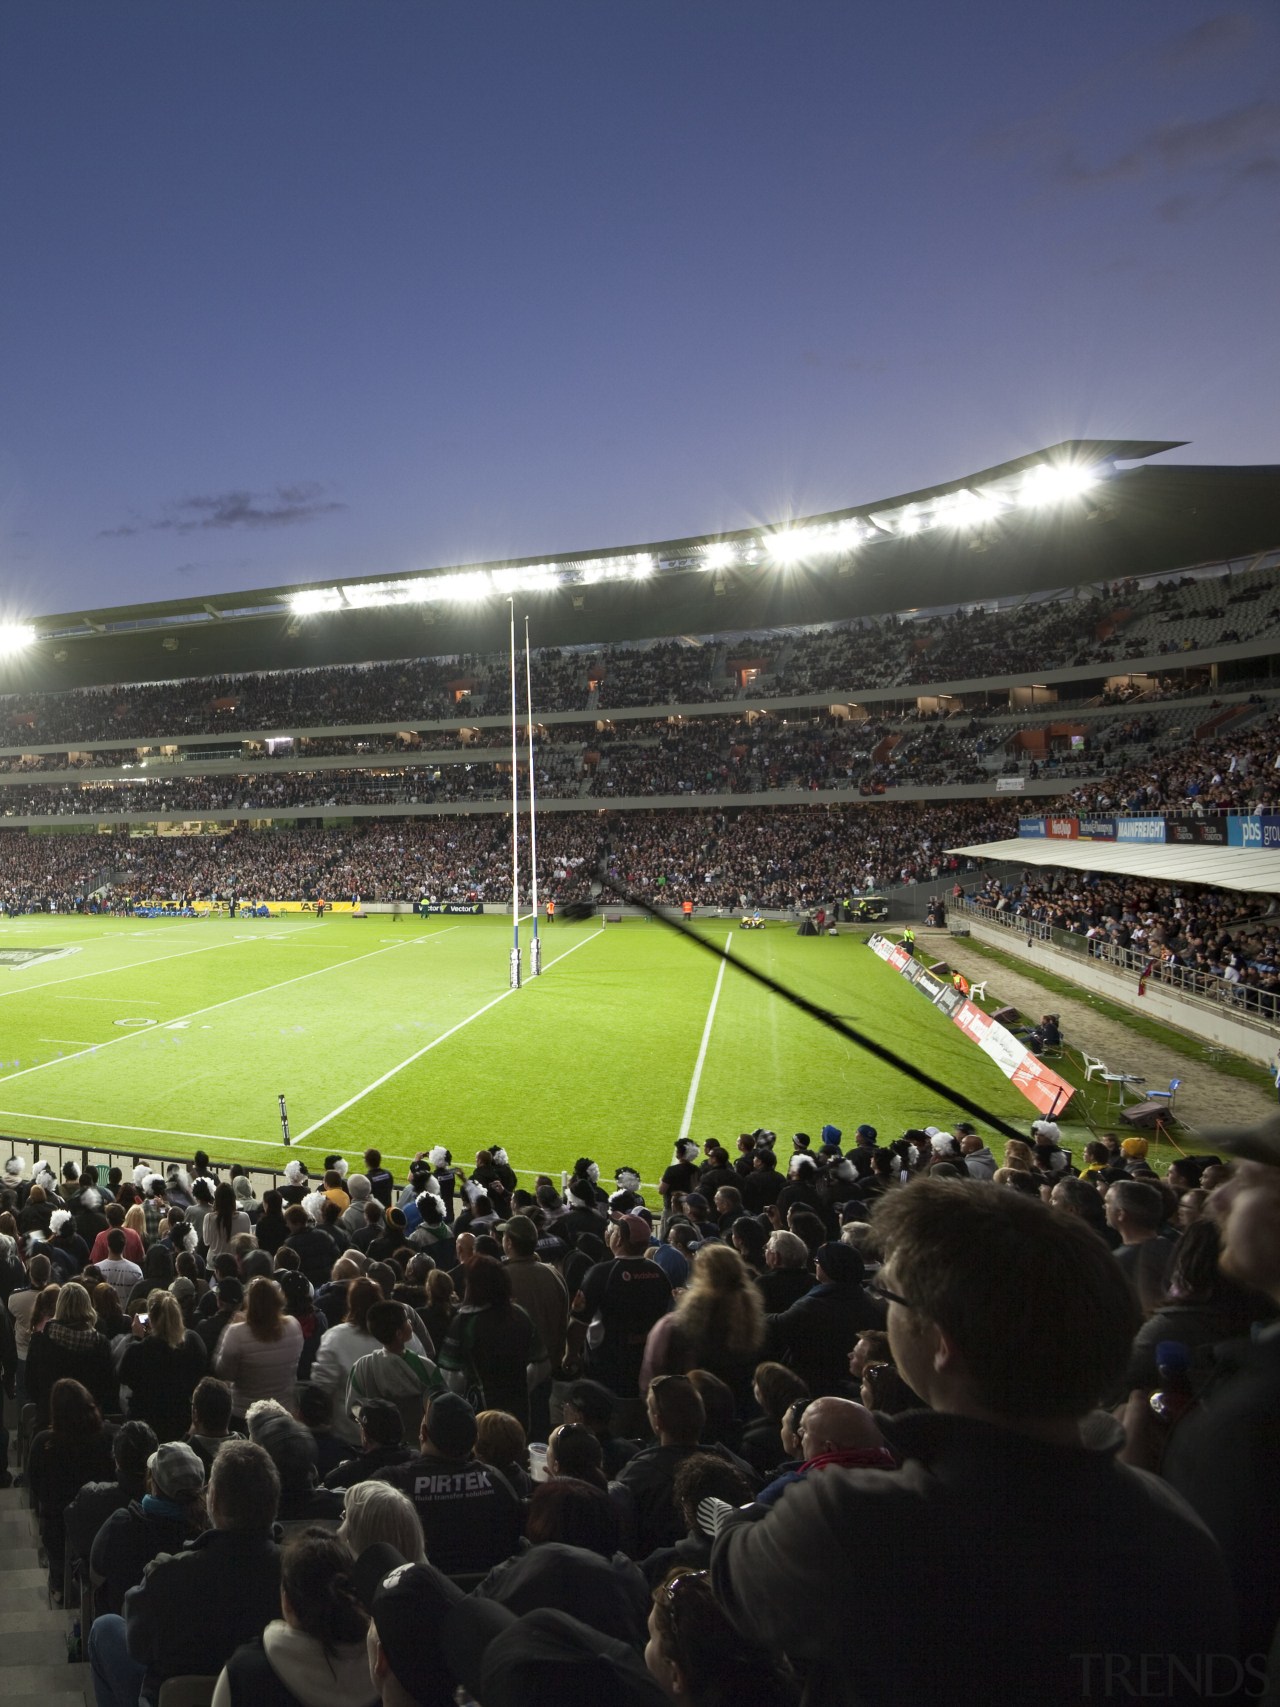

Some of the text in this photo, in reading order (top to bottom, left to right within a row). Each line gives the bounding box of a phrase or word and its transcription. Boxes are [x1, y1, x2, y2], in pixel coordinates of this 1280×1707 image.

[1118, 821, 1165, 838] MAINFREIGHT
[1242, 816, 1262, 847] pbs
[414, 1470, 492, 1494] PIRTEK
[434, 1492, 464, 1501] transfer
[465, 1488, 495, 1498] solutions
